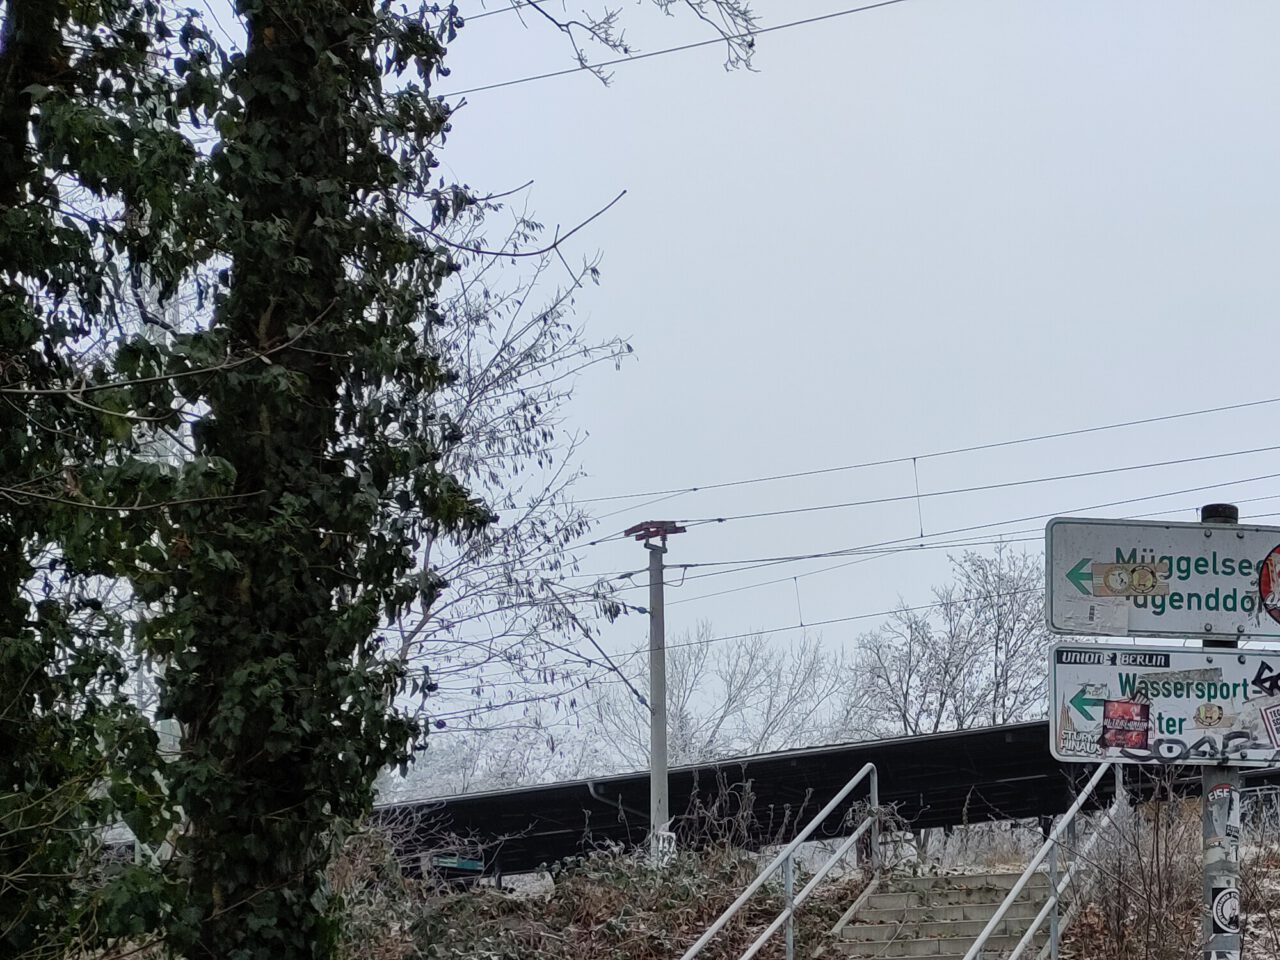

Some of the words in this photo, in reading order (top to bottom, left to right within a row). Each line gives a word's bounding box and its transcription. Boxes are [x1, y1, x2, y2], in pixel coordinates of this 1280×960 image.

[1062, 652, 1104, 664] UNION
[1120, 653, 1165, 666] BERLIN
[1061, 730, 1101, 744] STURM
